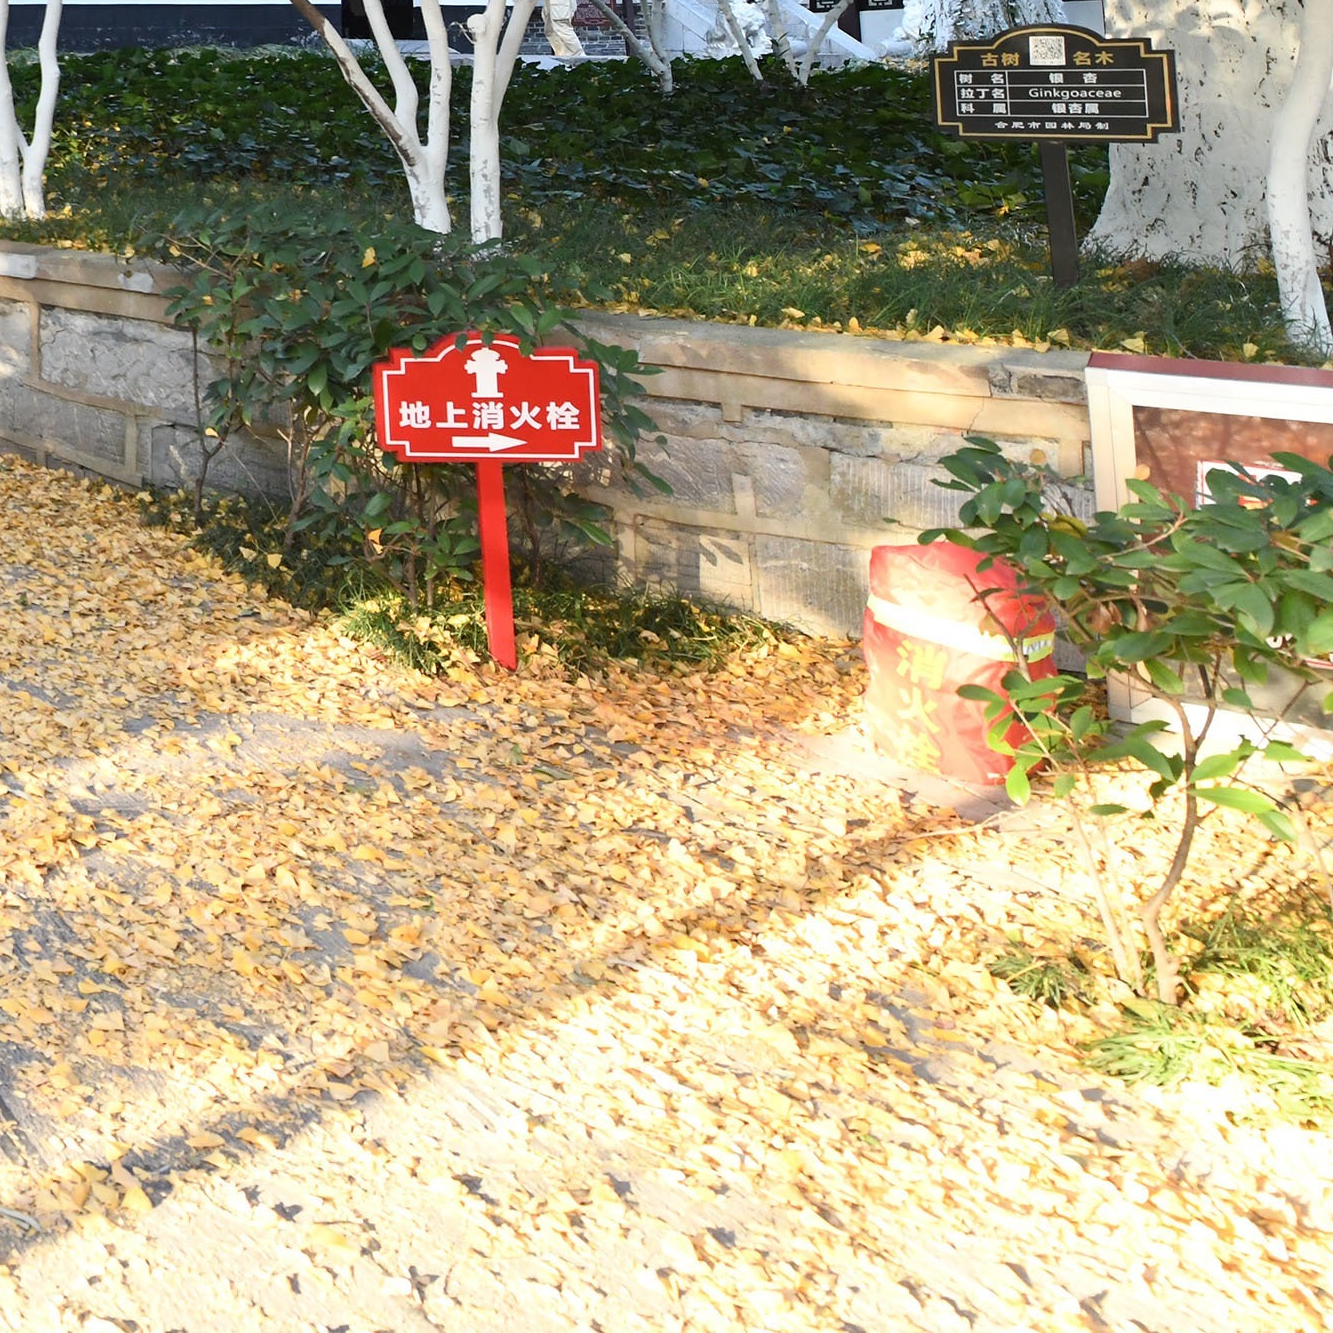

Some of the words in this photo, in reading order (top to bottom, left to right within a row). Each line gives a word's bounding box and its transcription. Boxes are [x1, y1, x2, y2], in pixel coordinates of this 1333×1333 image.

[980, 52, 1021, 67] 古树
[1073, 51, 1115, 66] 名木
[958, 73, 1005, 84] 树名
[1048, 72, 1098, 84] 银杏
[960, 88, 1006, 99] 拉丁名
[1028, 88, 1122, 100] Ginkgoaceae
[960, 102, 1007, 114] 科属
[1051, 103, 1100, 114] 银杏属
[994, 121, 1110, 130] 合肥市园林局制
[398, 400, 581, 431] 地上消火栓
